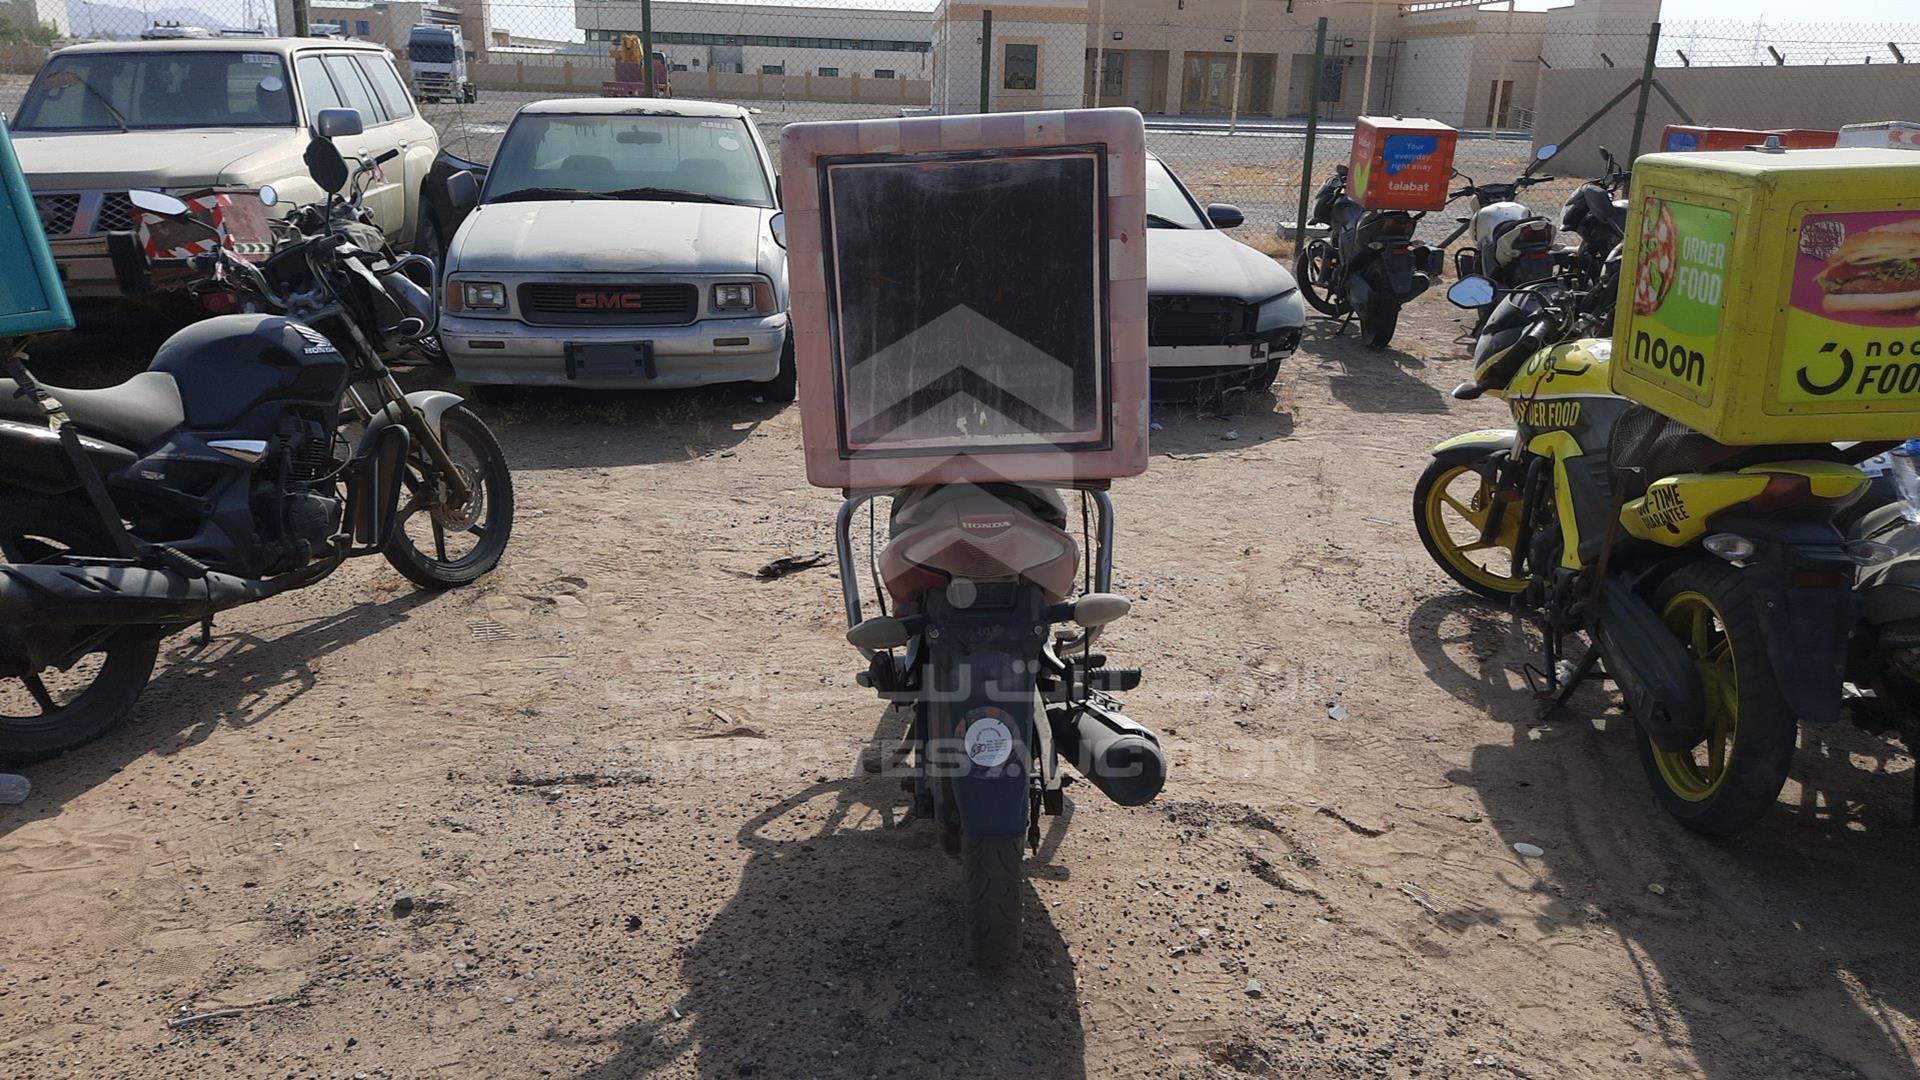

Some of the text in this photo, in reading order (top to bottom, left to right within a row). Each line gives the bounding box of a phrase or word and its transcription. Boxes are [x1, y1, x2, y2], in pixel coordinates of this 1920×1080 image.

[1391, 163, 1411, 171] right
[1388, 181, 1430, 192] talabat
[1682, 236, 1726, 270] ORDER
[1677, 266, 1722, 306] FOOD
[576, 294, 642, 309] GMC
[1634, 330, 1705, 387] noon
[1855, 363, 1920, 395] FOO
[1548, 401, 1581, 427] FOOD
[962, 521, 1012, 529] HONDA
